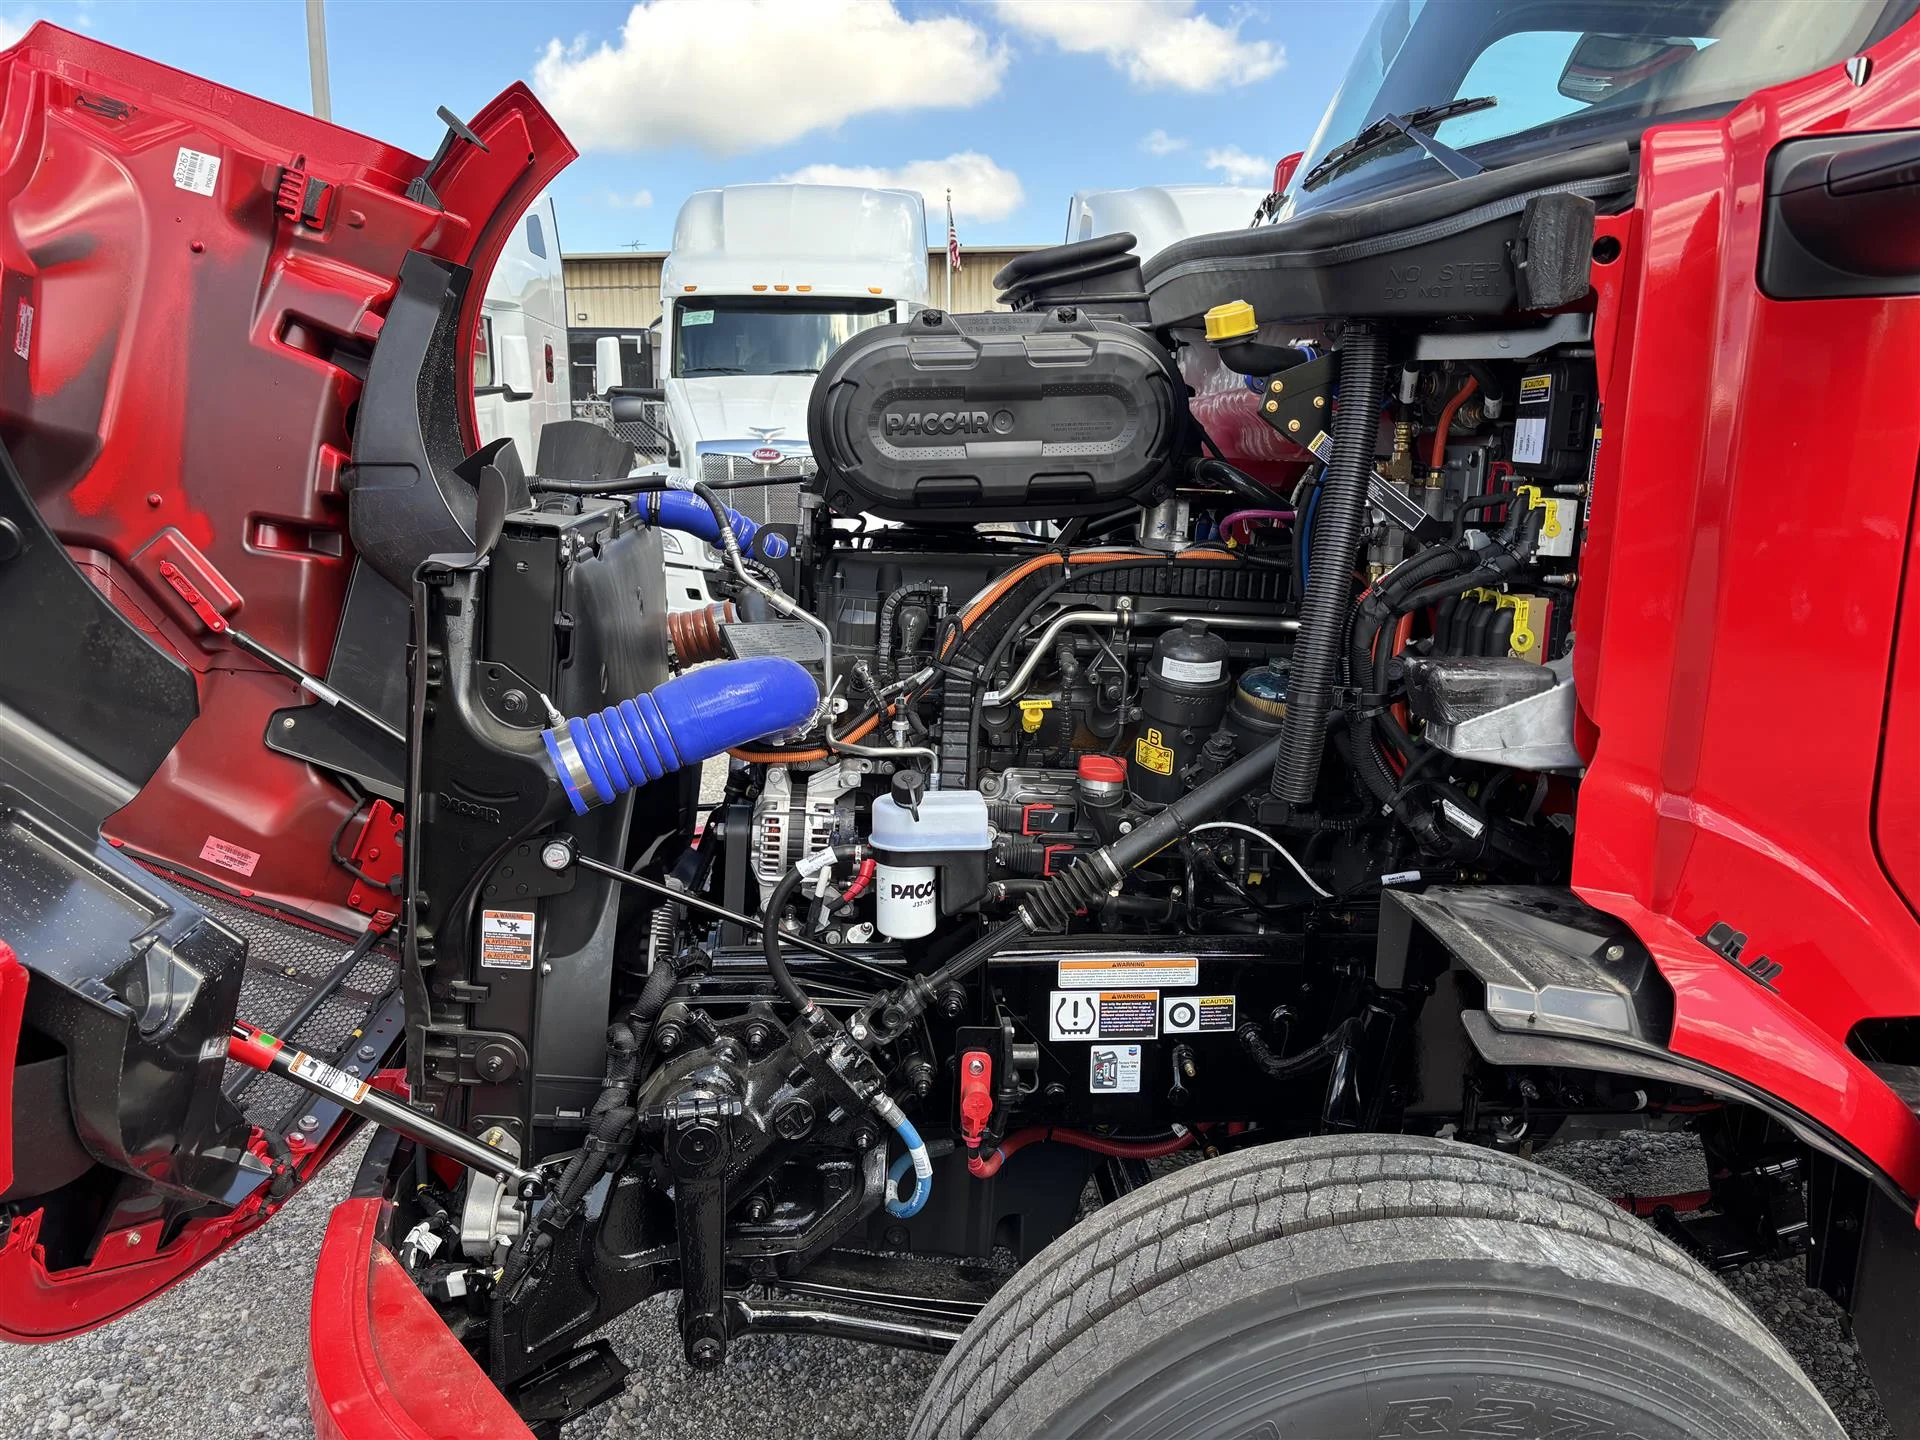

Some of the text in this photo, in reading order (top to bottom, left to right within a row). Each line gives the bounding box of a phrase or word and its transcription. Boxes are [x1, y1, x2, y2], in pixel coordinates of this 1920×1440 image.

[176, 152, 190, 183] 832267
[1386, 262, 1501, 284] NO STEP
[1383, 283, 1505, 300] DO NOT PULL
[886, 411, 990, 436] PACCAR
[1149, 731, 1160, 745] B
[499, 912, 525, 920] WARNING
